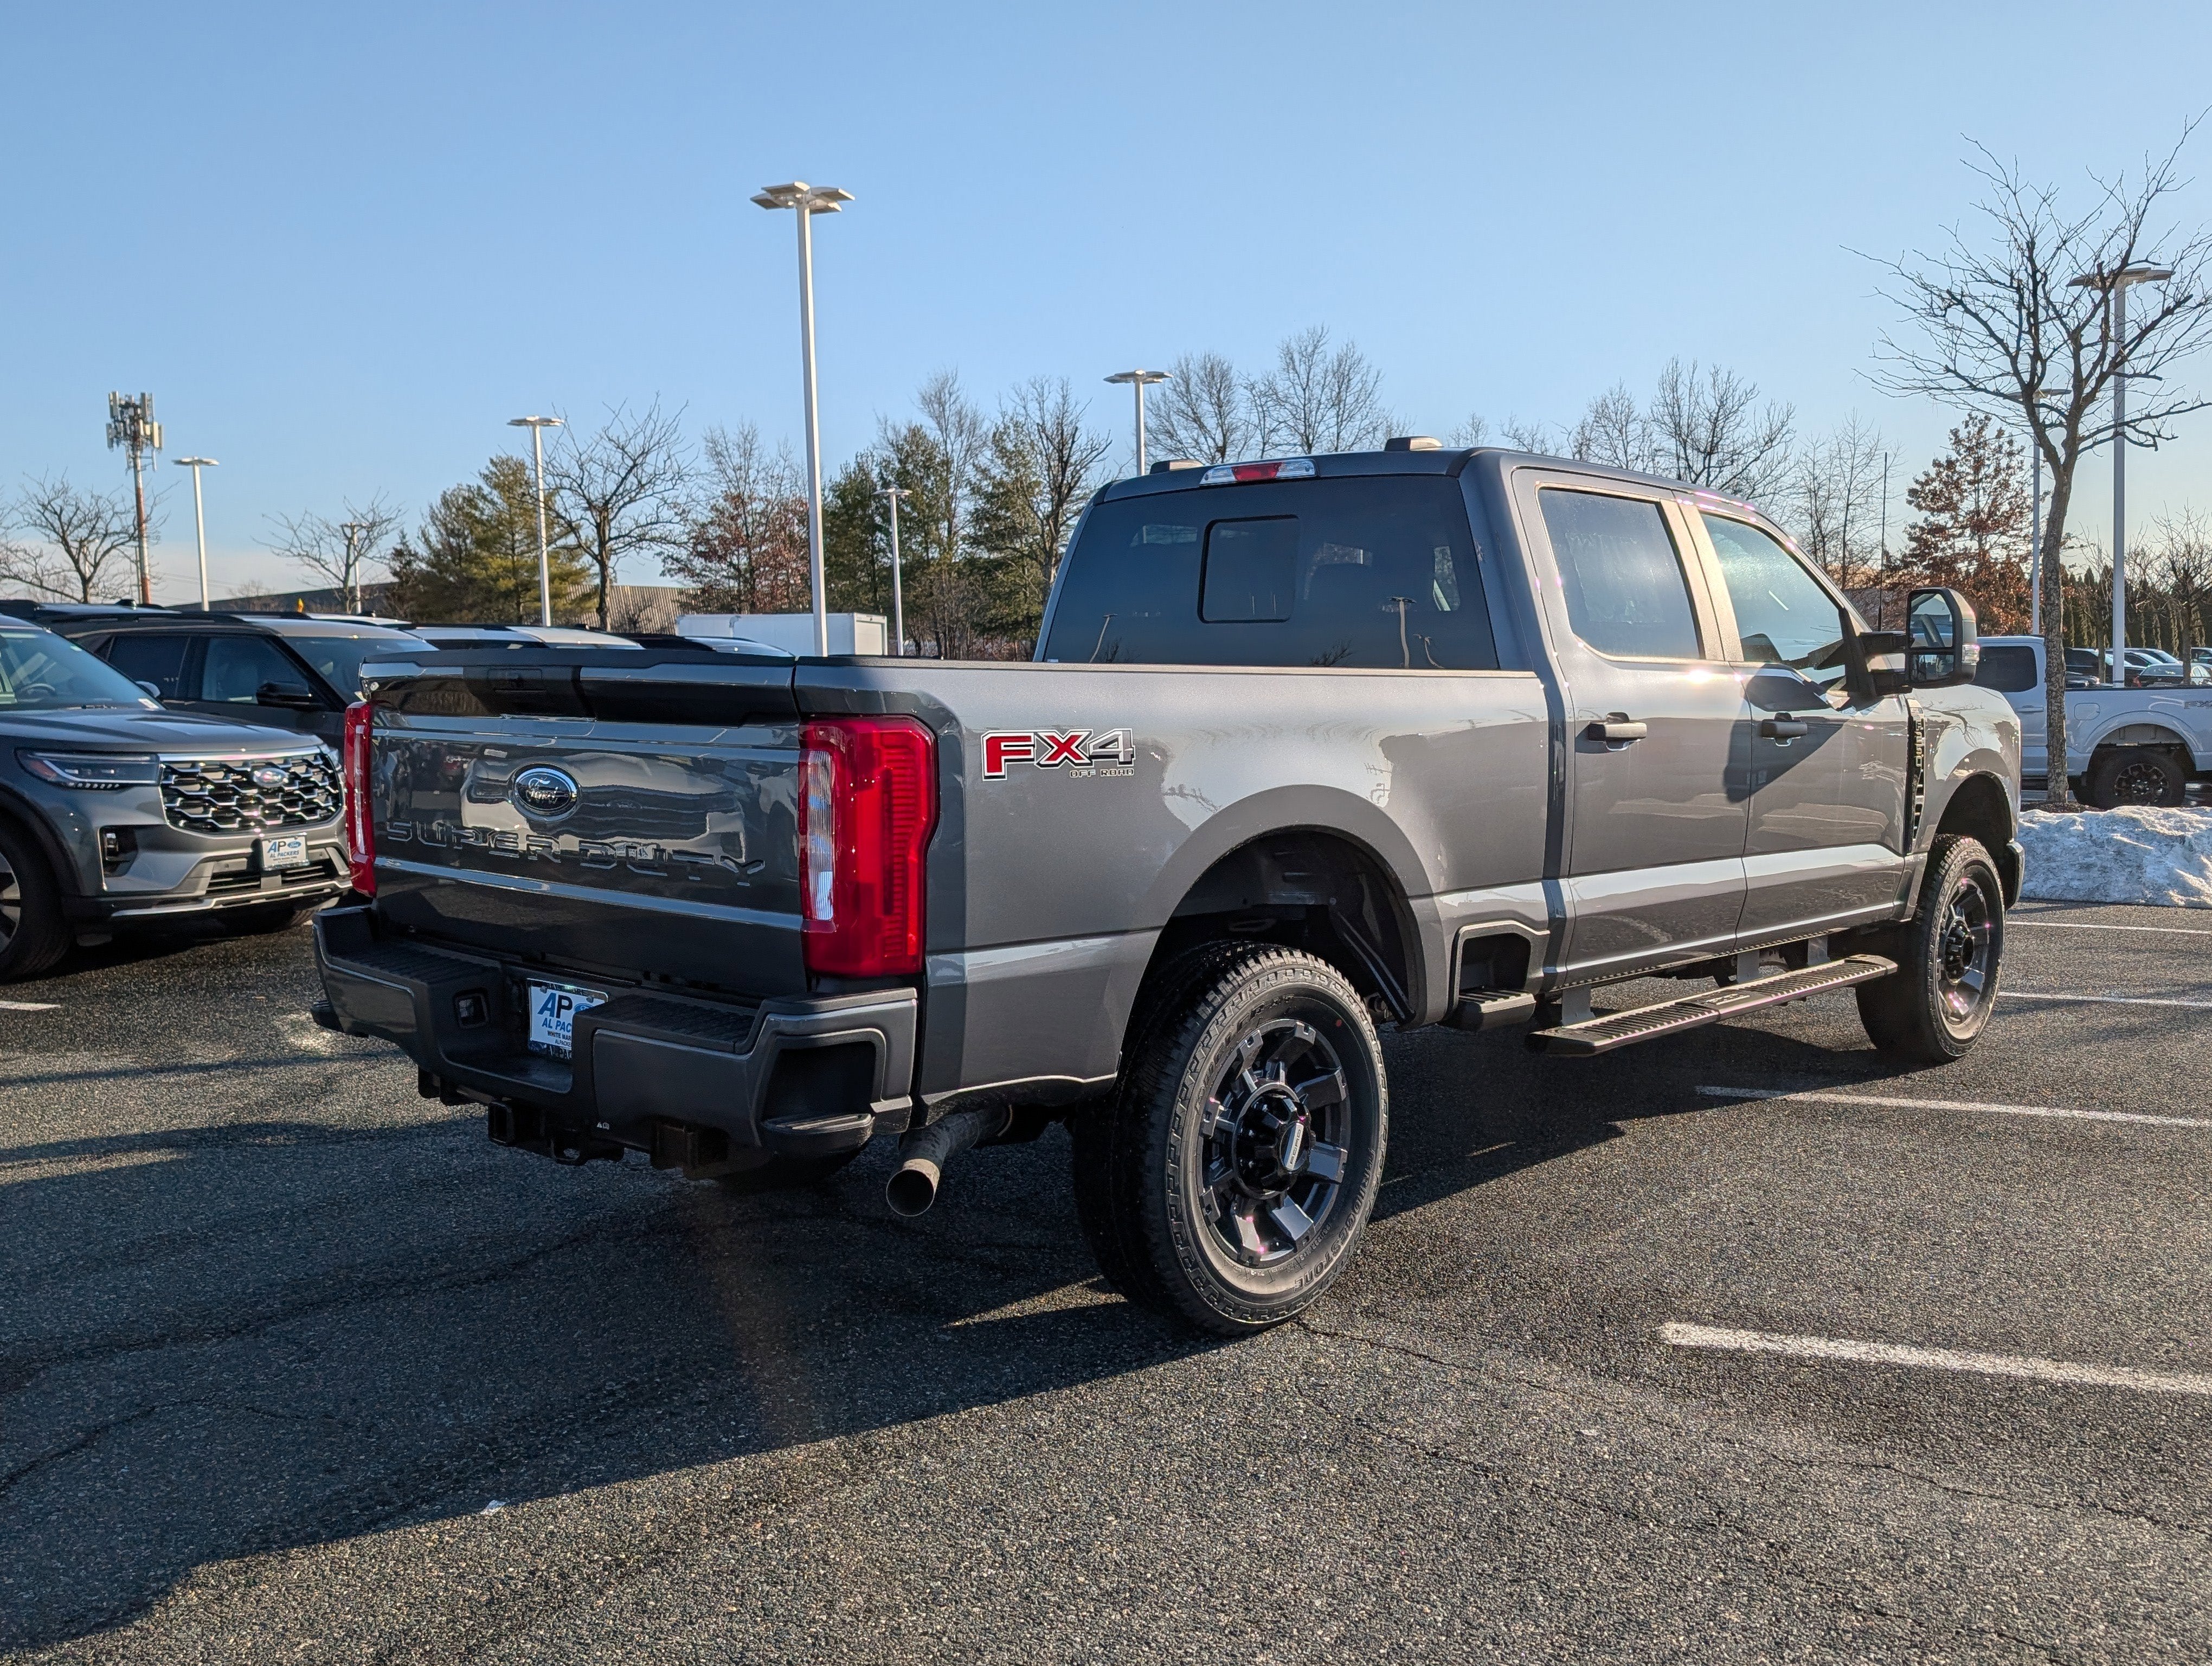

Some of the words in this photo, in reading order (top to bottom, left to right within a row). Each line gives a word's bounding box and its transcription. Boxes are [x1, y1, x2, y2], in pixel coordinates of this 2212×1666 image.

[981, 728, 1136, 781] FX4
[1069, 770, 1096, 778] OFF
[1101, 768, 1134, 777] ROAD
[267, 841, 286, 853] AP
[387, 819, 561, 863] SUPER
[578, 838, 766, 886] DUTY
[537, 992, 573, 1019] AP
[542, 1017, 553, 1029] AL
[1290, 1129, 1301, 1165] FORD
